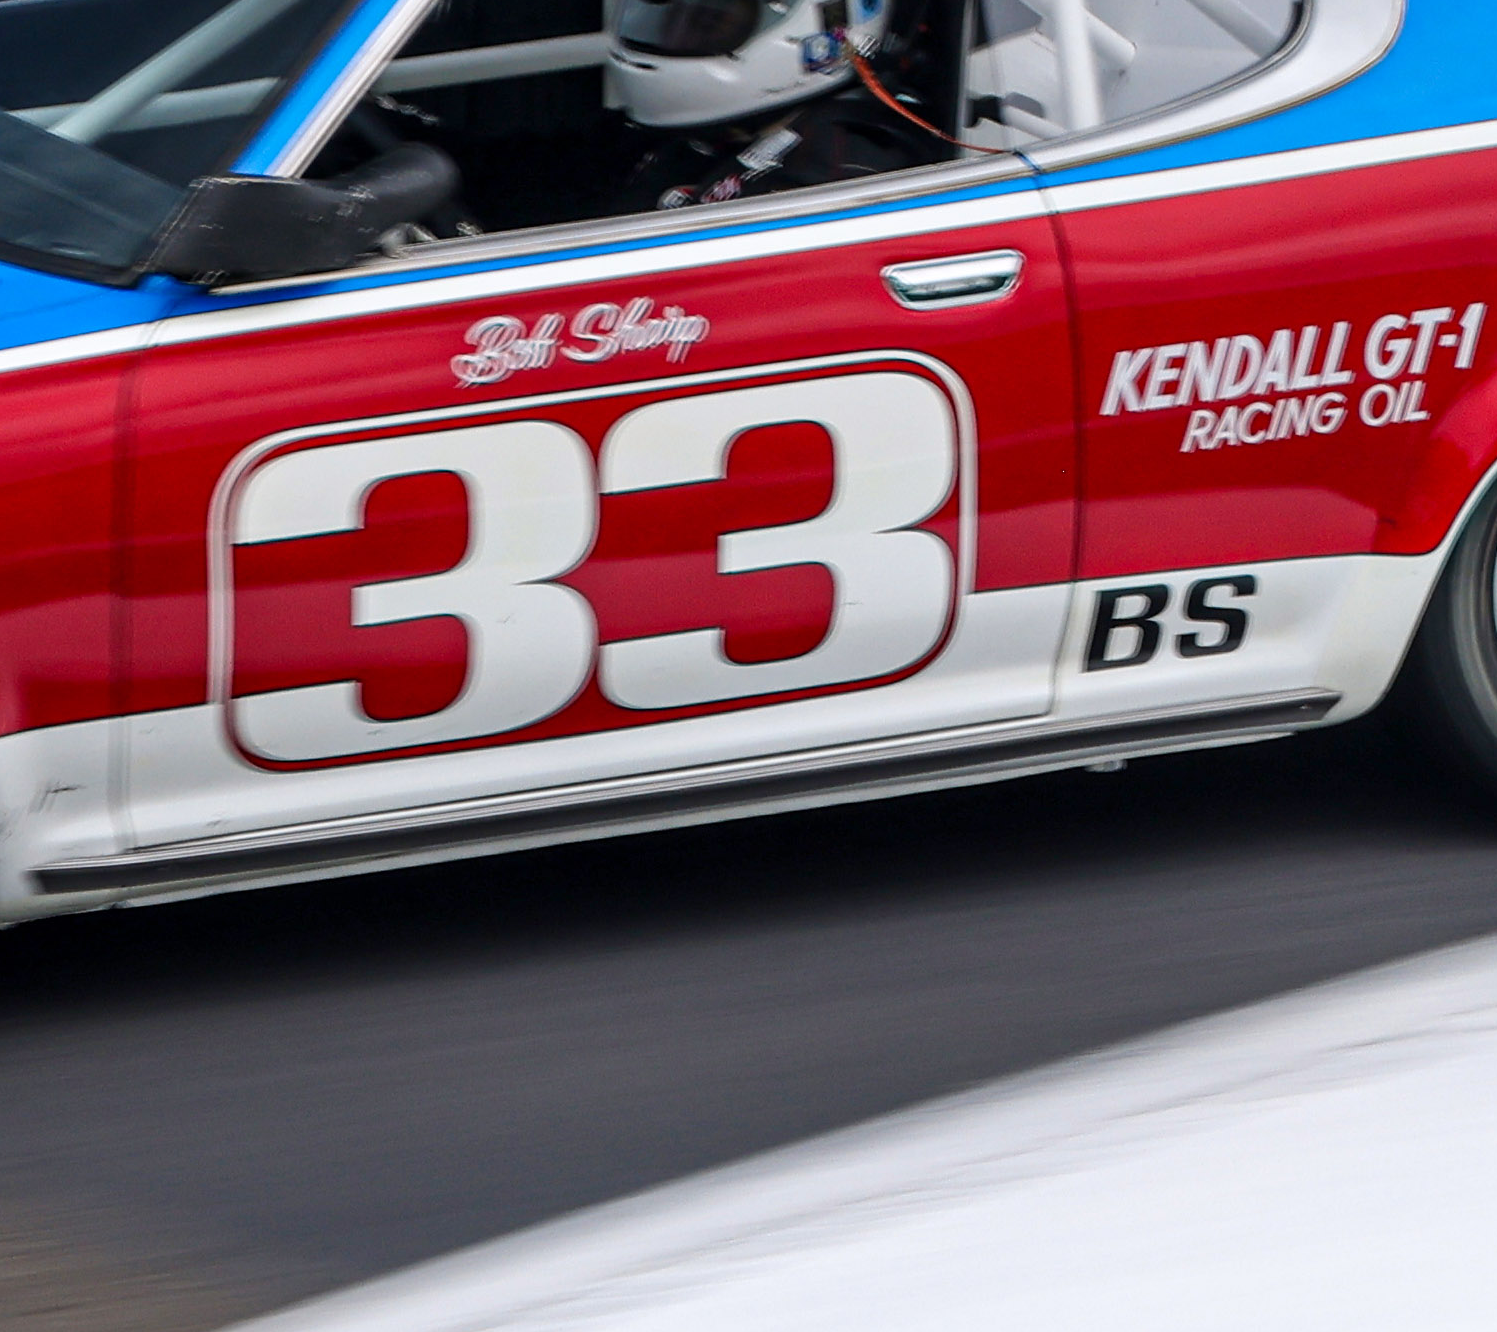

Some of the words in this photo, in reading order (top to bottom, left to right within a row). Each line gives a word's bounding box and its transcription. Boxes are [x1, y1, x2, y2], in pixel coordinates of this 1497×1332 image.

[1099, 321, 1358, 416] KENDALL
[1364, 302, 1489, 380] GT-1
[1179, 391, 1349, 453] RACING
[1359, 380, 1432, 428] OIL
[230, 371, 959, 762] 33
[1080, 574, 1257, 673] BS
